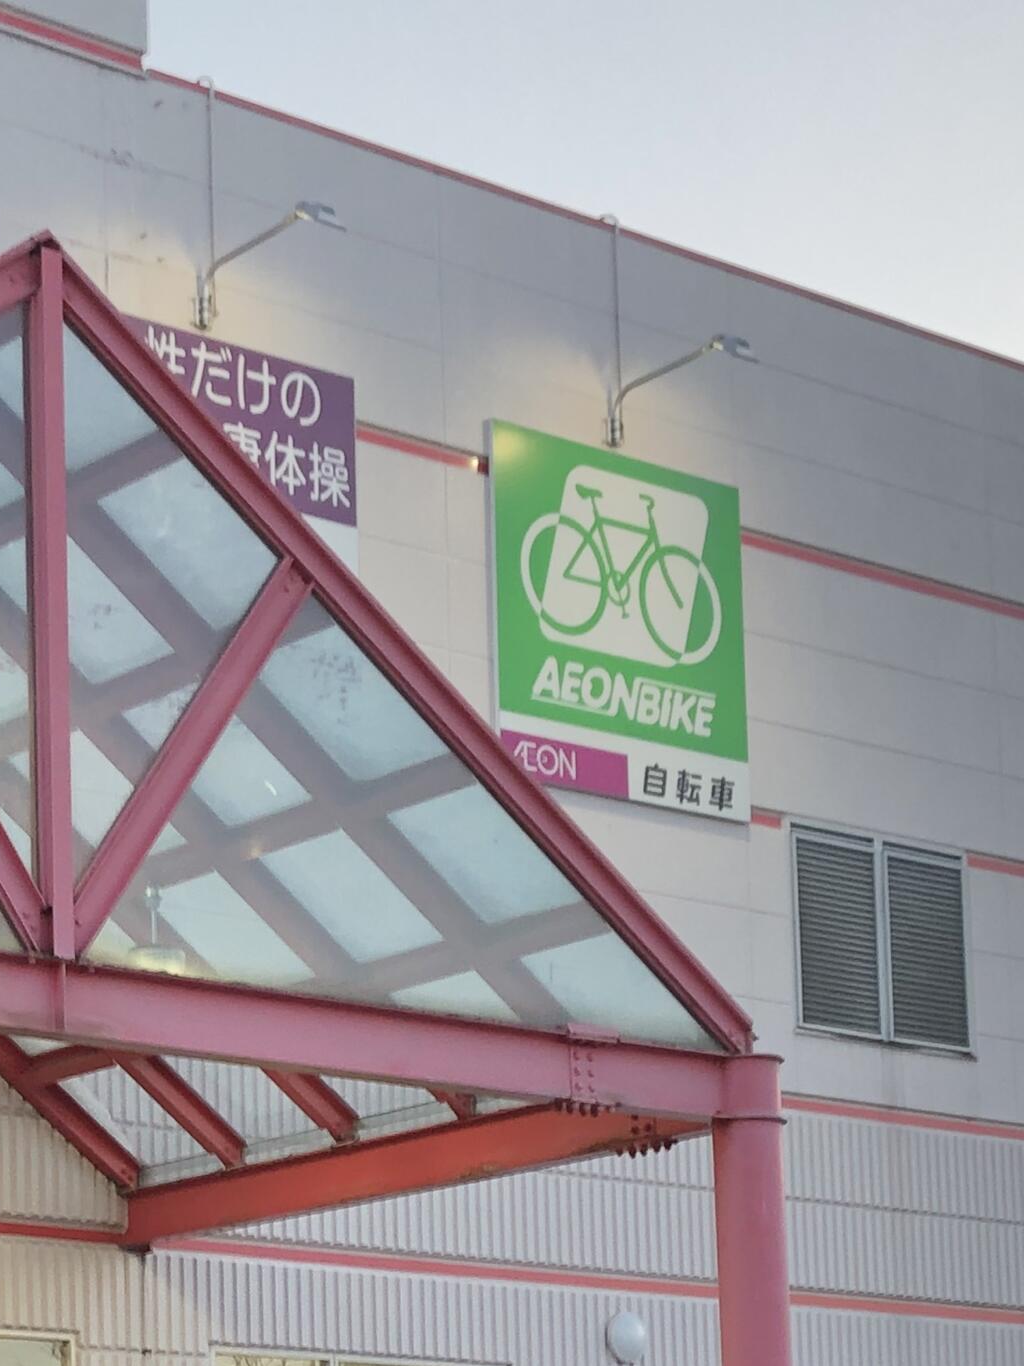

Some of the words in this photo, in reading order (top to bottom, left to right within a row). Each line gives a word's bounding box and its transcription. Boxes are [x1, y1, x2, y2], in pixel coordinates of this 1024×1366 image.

[531, 656, 716, 737] AEONBIKE
[643, 763, 735, 811] 自転車
